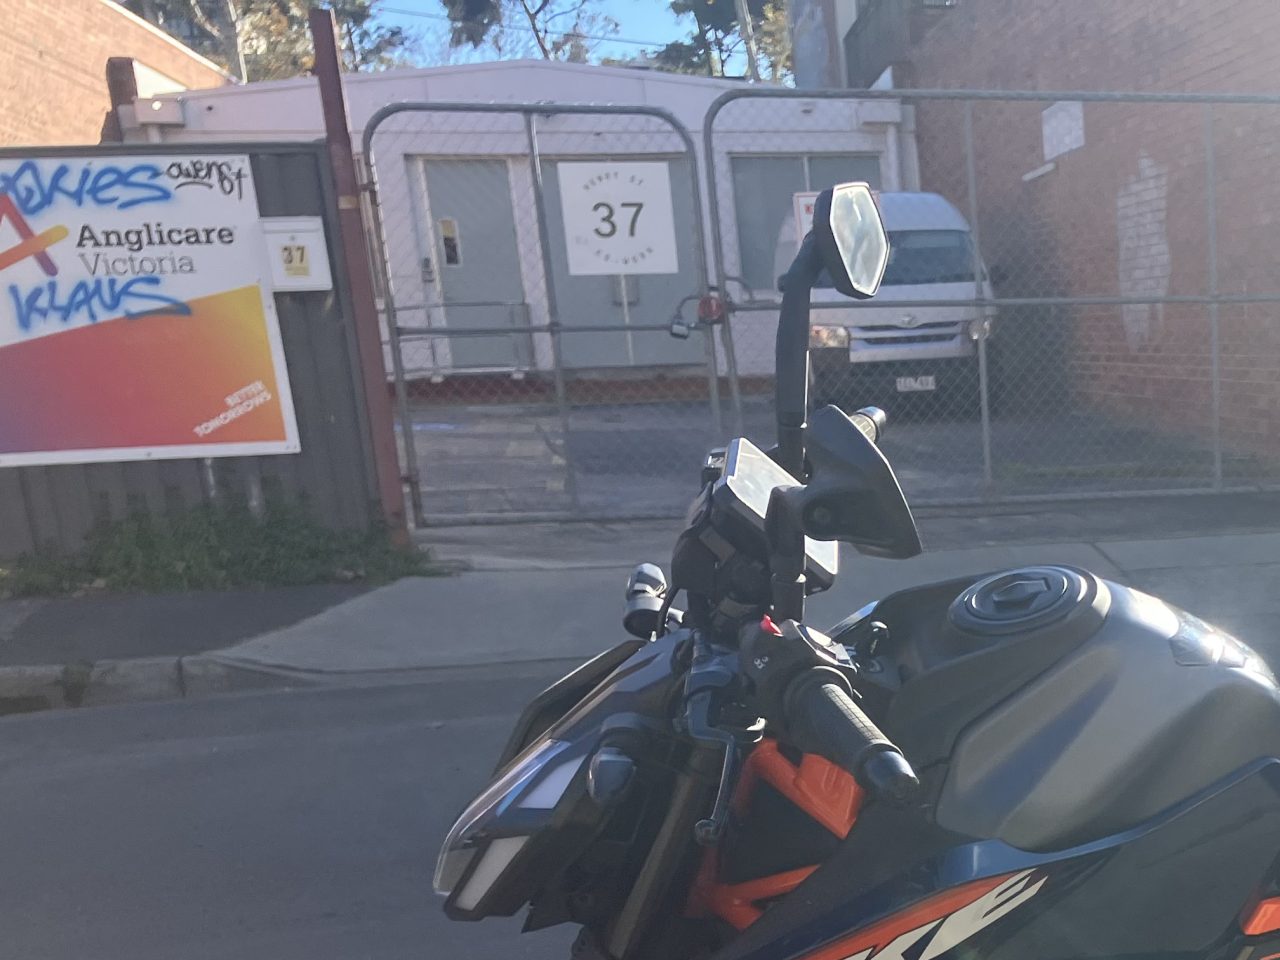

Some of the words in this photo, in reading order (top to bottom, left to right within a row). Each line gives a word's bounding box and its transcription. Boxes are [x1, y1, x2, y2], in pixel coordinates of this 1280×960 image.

[592, 202, 644, 238] 37
[76, 223, 234, 252] Anglicare
[79, 251, 196, 276] Victoria
[281, 246, 305, 264] 37
